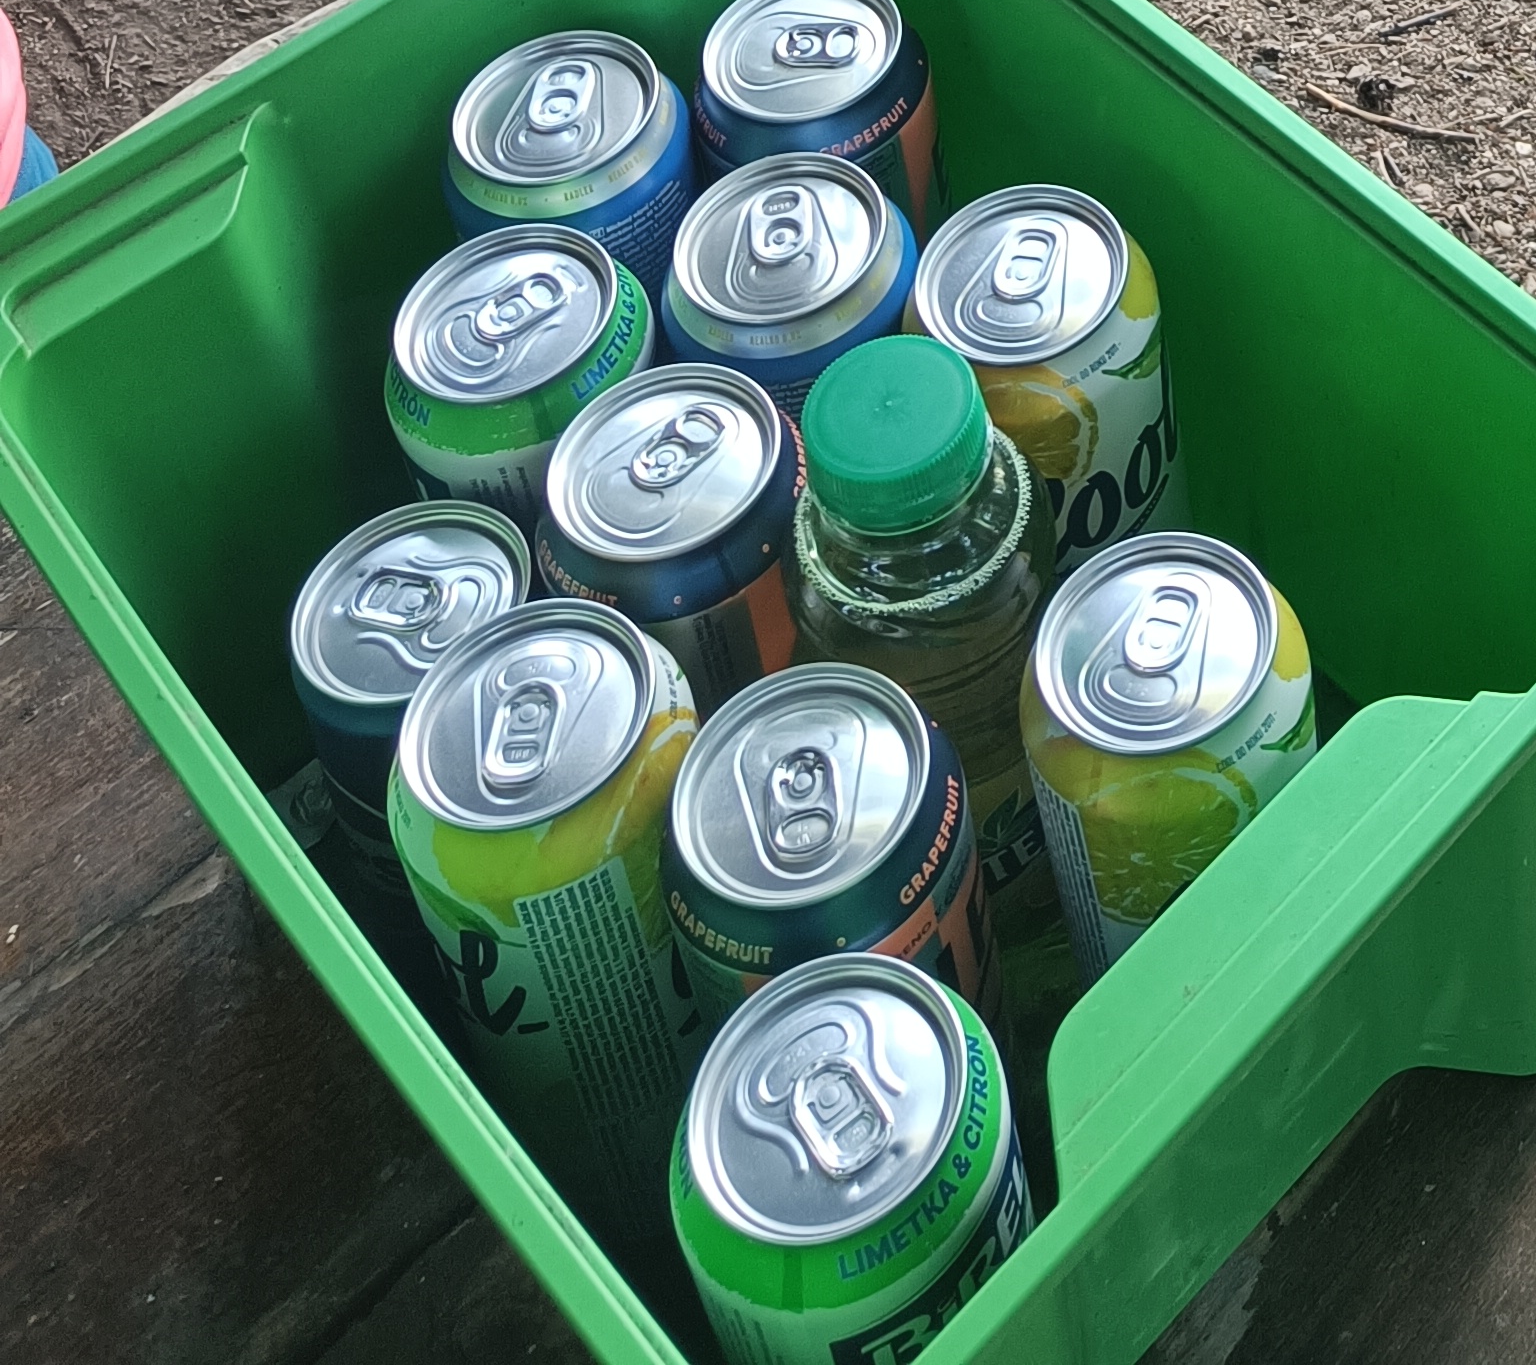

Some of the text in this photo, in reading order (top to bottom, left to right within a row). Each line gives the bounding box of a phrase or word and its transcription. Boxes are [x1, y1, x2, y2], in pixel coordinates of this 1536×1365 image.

[570, 313, 636, 403] LIMETKA
[622, 299, 637, 315] &
[900, 774, 960, 906] GRAPEFRUIT
[670, 890, 774, 966] GRAPEFRUIT
[836, 1178, 960, 1281] LIMETKA
[951, 1153, 972, 1180] &
